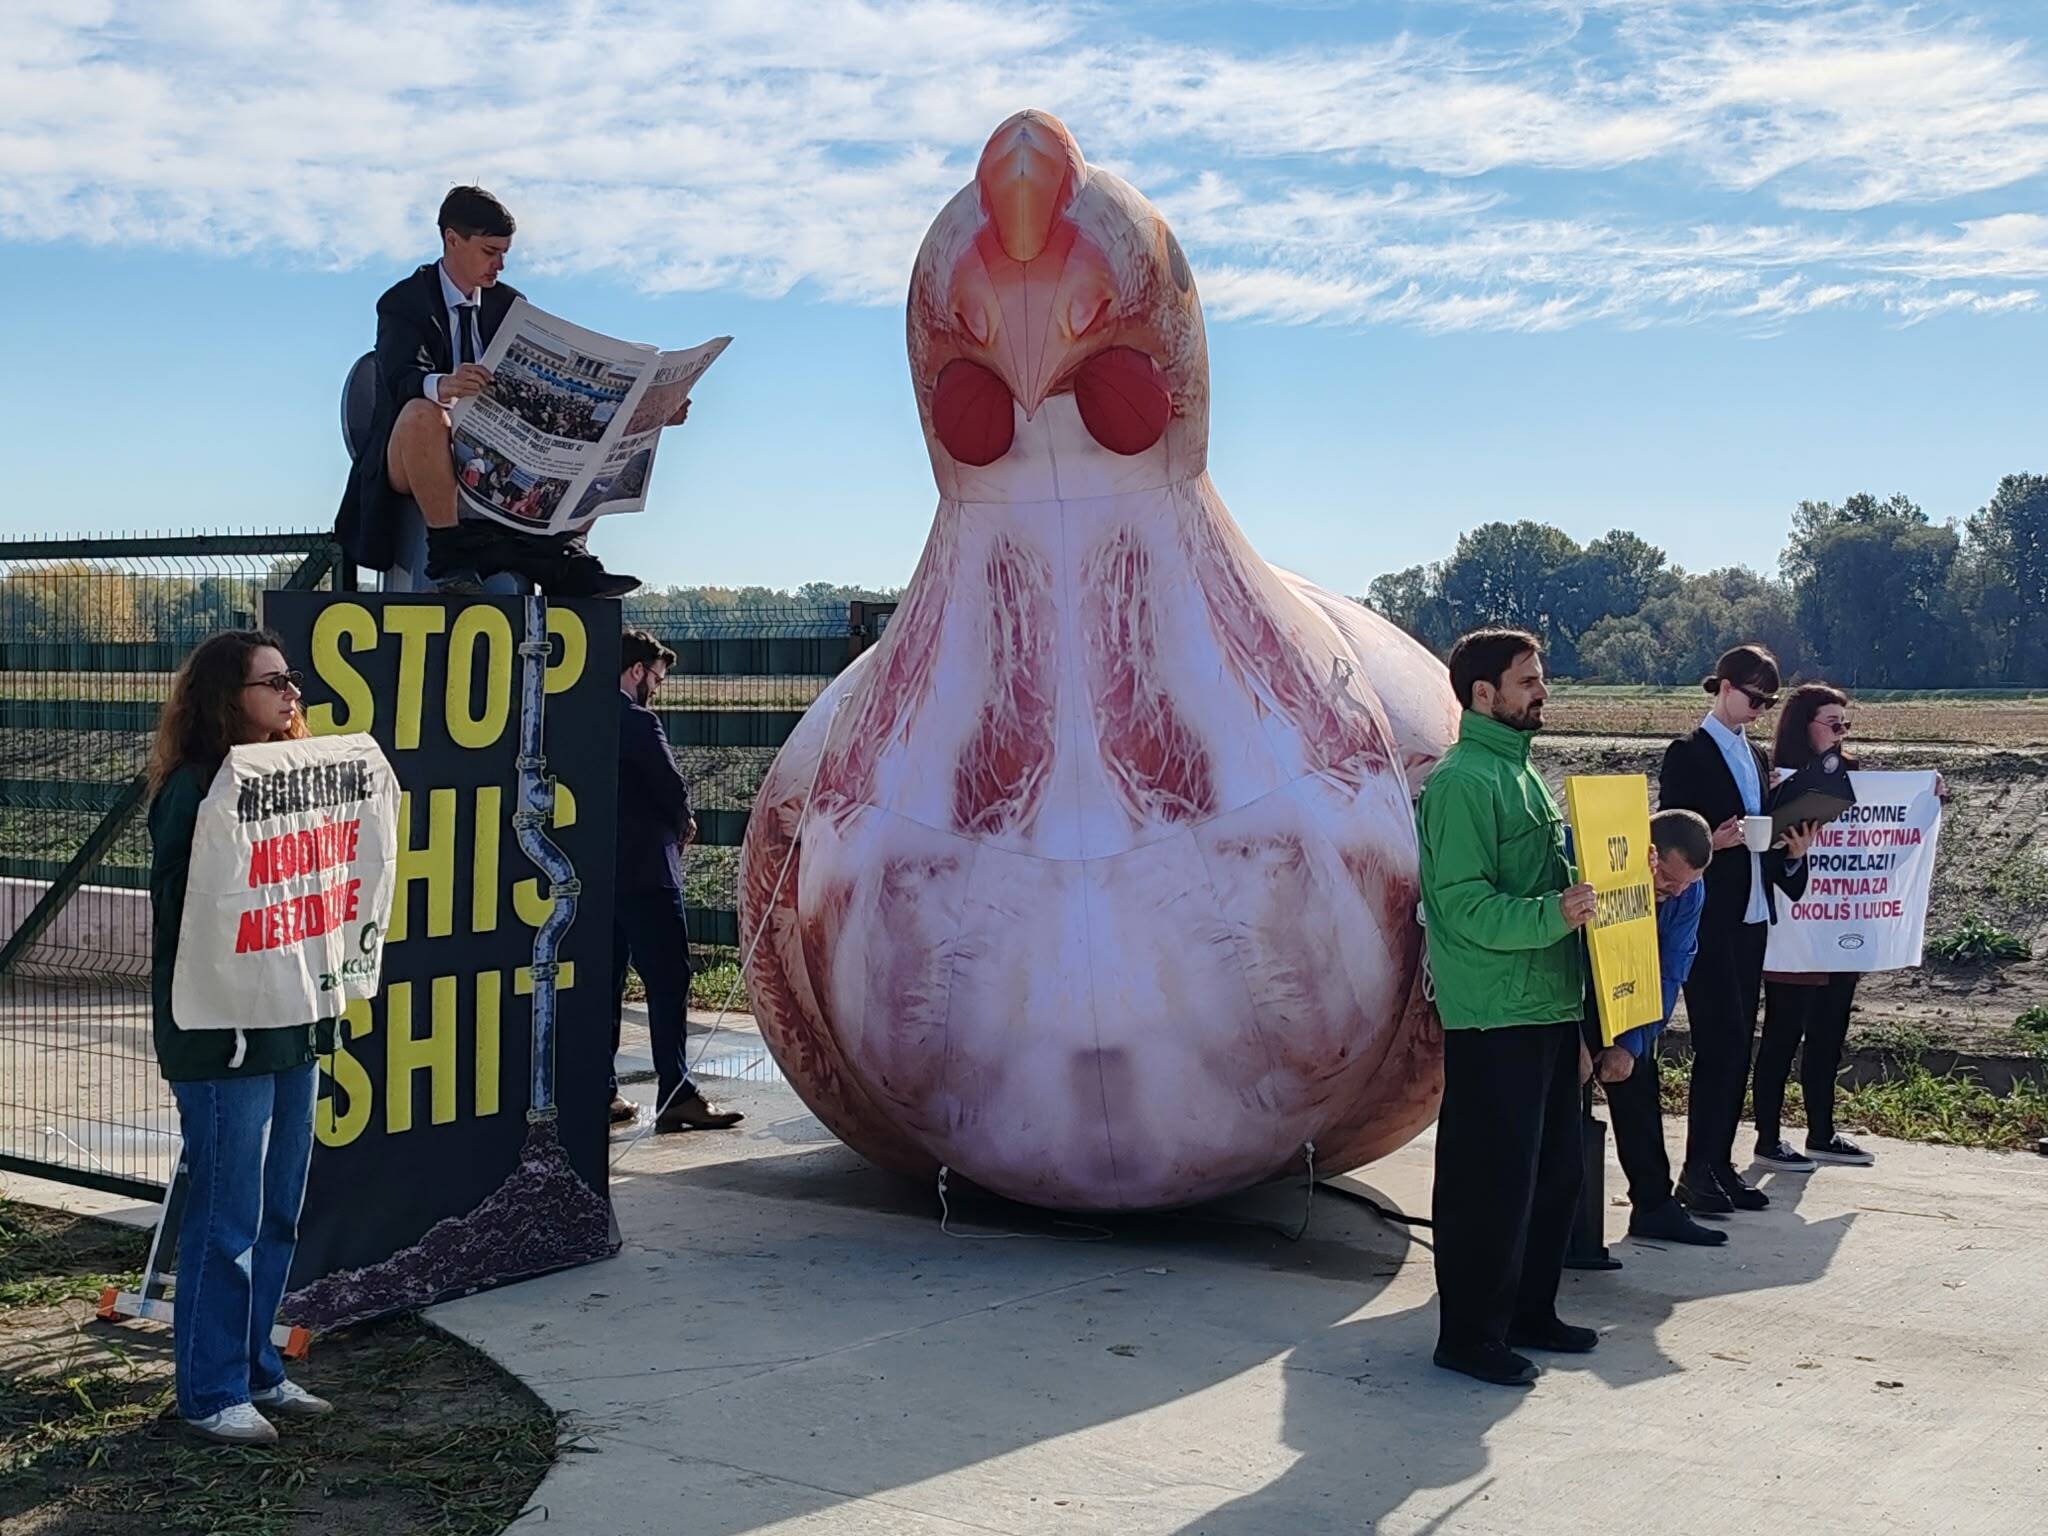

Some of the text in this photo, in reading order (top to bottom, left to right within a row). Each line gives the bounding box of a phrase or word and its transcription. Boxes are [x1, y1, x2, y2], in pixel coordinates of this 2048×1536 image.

[306, 602, 587, 749] STOP
[1832, 805, 1907, 823] GROMNE
[1846, 824, 1921, 847] ŽIVOTINJA
[385, 782, 577, 943] HIS
[1608, 835, 1629, 872] STOP
[1809, 853, 1896, 871] PROIZLAZI I
[1811, 877, 1888, 895] PATNJA ZA
[1593, 884, 1652, 930] EGAFARMAMA!
[1791, 897, 1850, 920] OKOLIŠ
[1855, 904, 1860, 919] I
[315, 961, 575, 1147] SHIT
